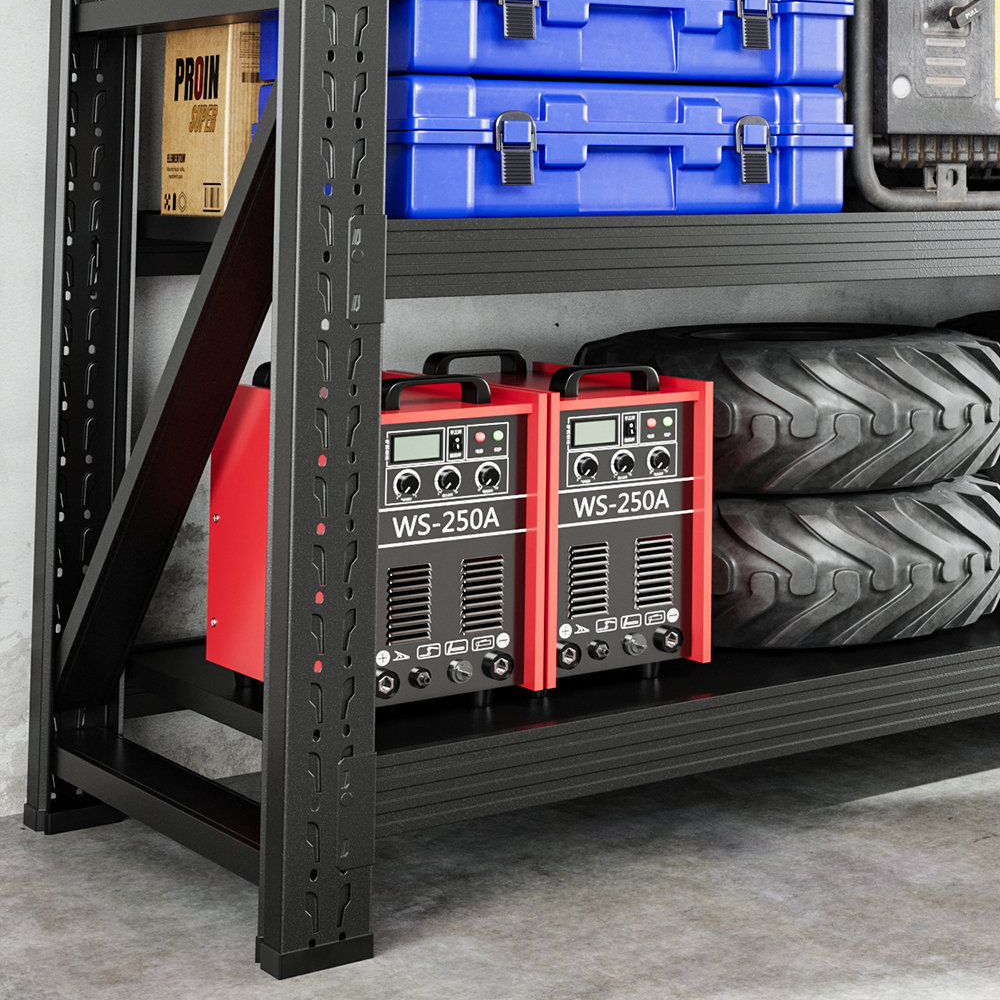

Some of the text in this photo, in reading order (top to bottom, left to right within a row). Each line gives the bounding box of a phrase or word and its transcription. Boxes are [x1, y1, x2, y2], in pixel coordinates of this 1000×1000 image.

[964, 7, 979, 20] PULL
[174, 54, 220, 102] PROIN
[188, 104, 219, 133] SUPER
[573, 488, 670, 518] WS-250A
[392, 506, 500, 539] WS-250A
